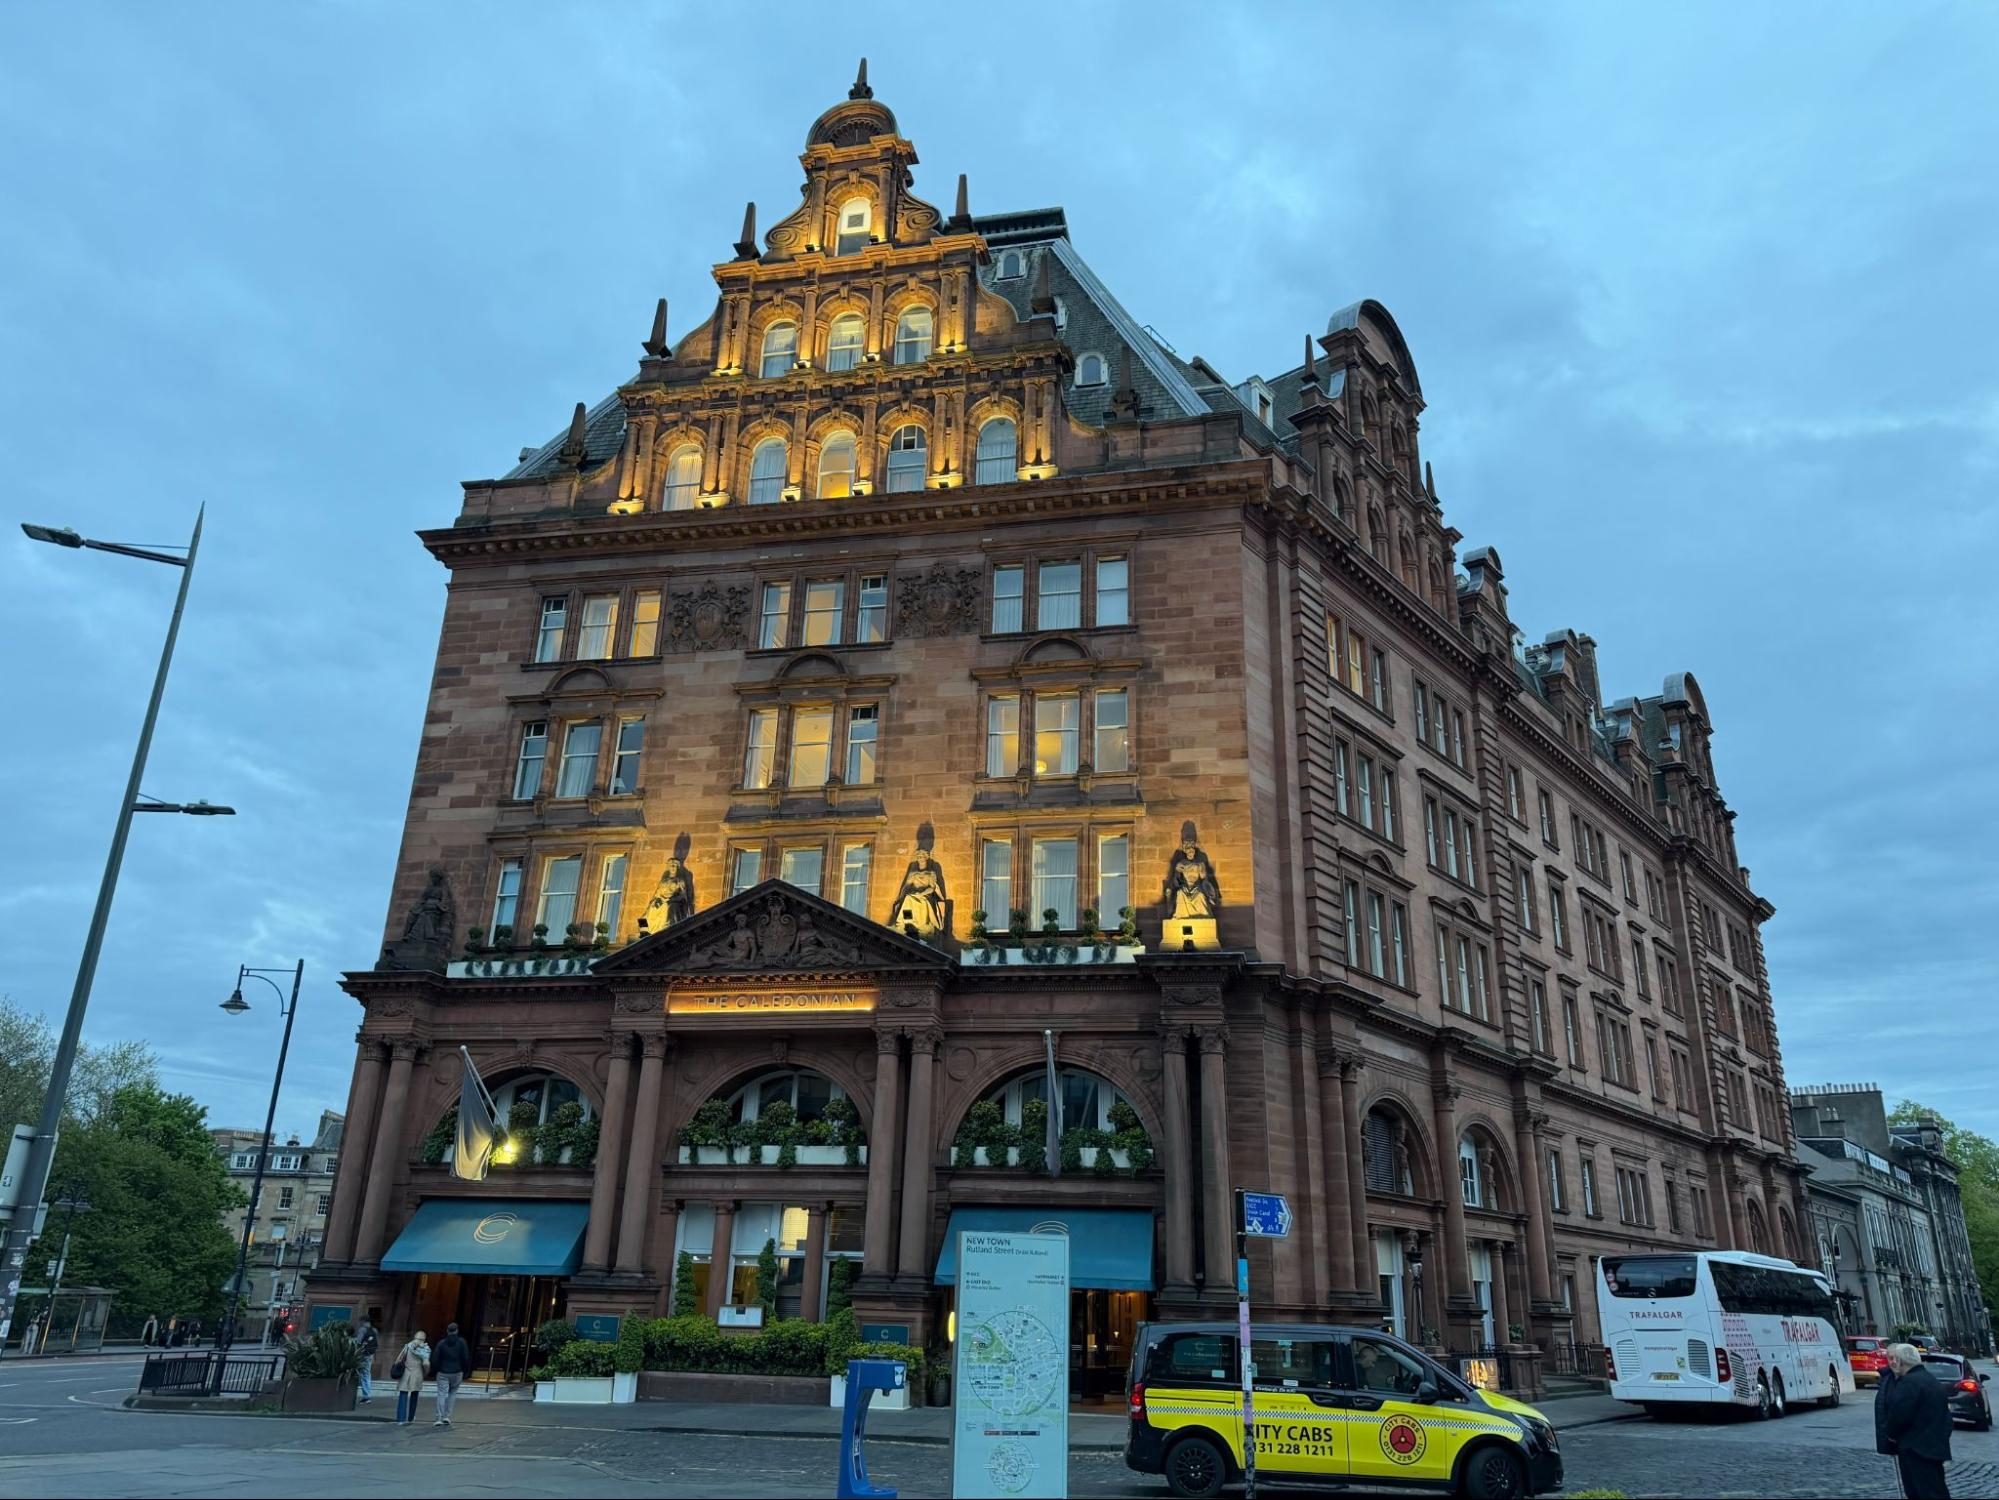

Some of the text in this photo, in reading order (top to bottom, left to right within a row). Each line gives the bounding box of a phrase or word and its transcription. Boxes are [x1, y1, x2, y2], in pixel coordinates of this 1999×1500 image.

[694, 993, 855, 1008] THE CALEDONIAN
[966, 1237, 1011, 1246] NEW TOWN
[966, 1245, 993, 1255] Rutland
[994, 1246, 1015, 1255] Street
[1629, 1311, 1683, 1319] TRAFALGAR
[1780, 1320, 1821, 1343] TRAFALGAR
[1251, 1424, 1333, 1442] ITY CABS
[1384, 1418, 1420, 1433] CITY CABS
[1251, 1441, 1334, 1456] 131 228 1211
